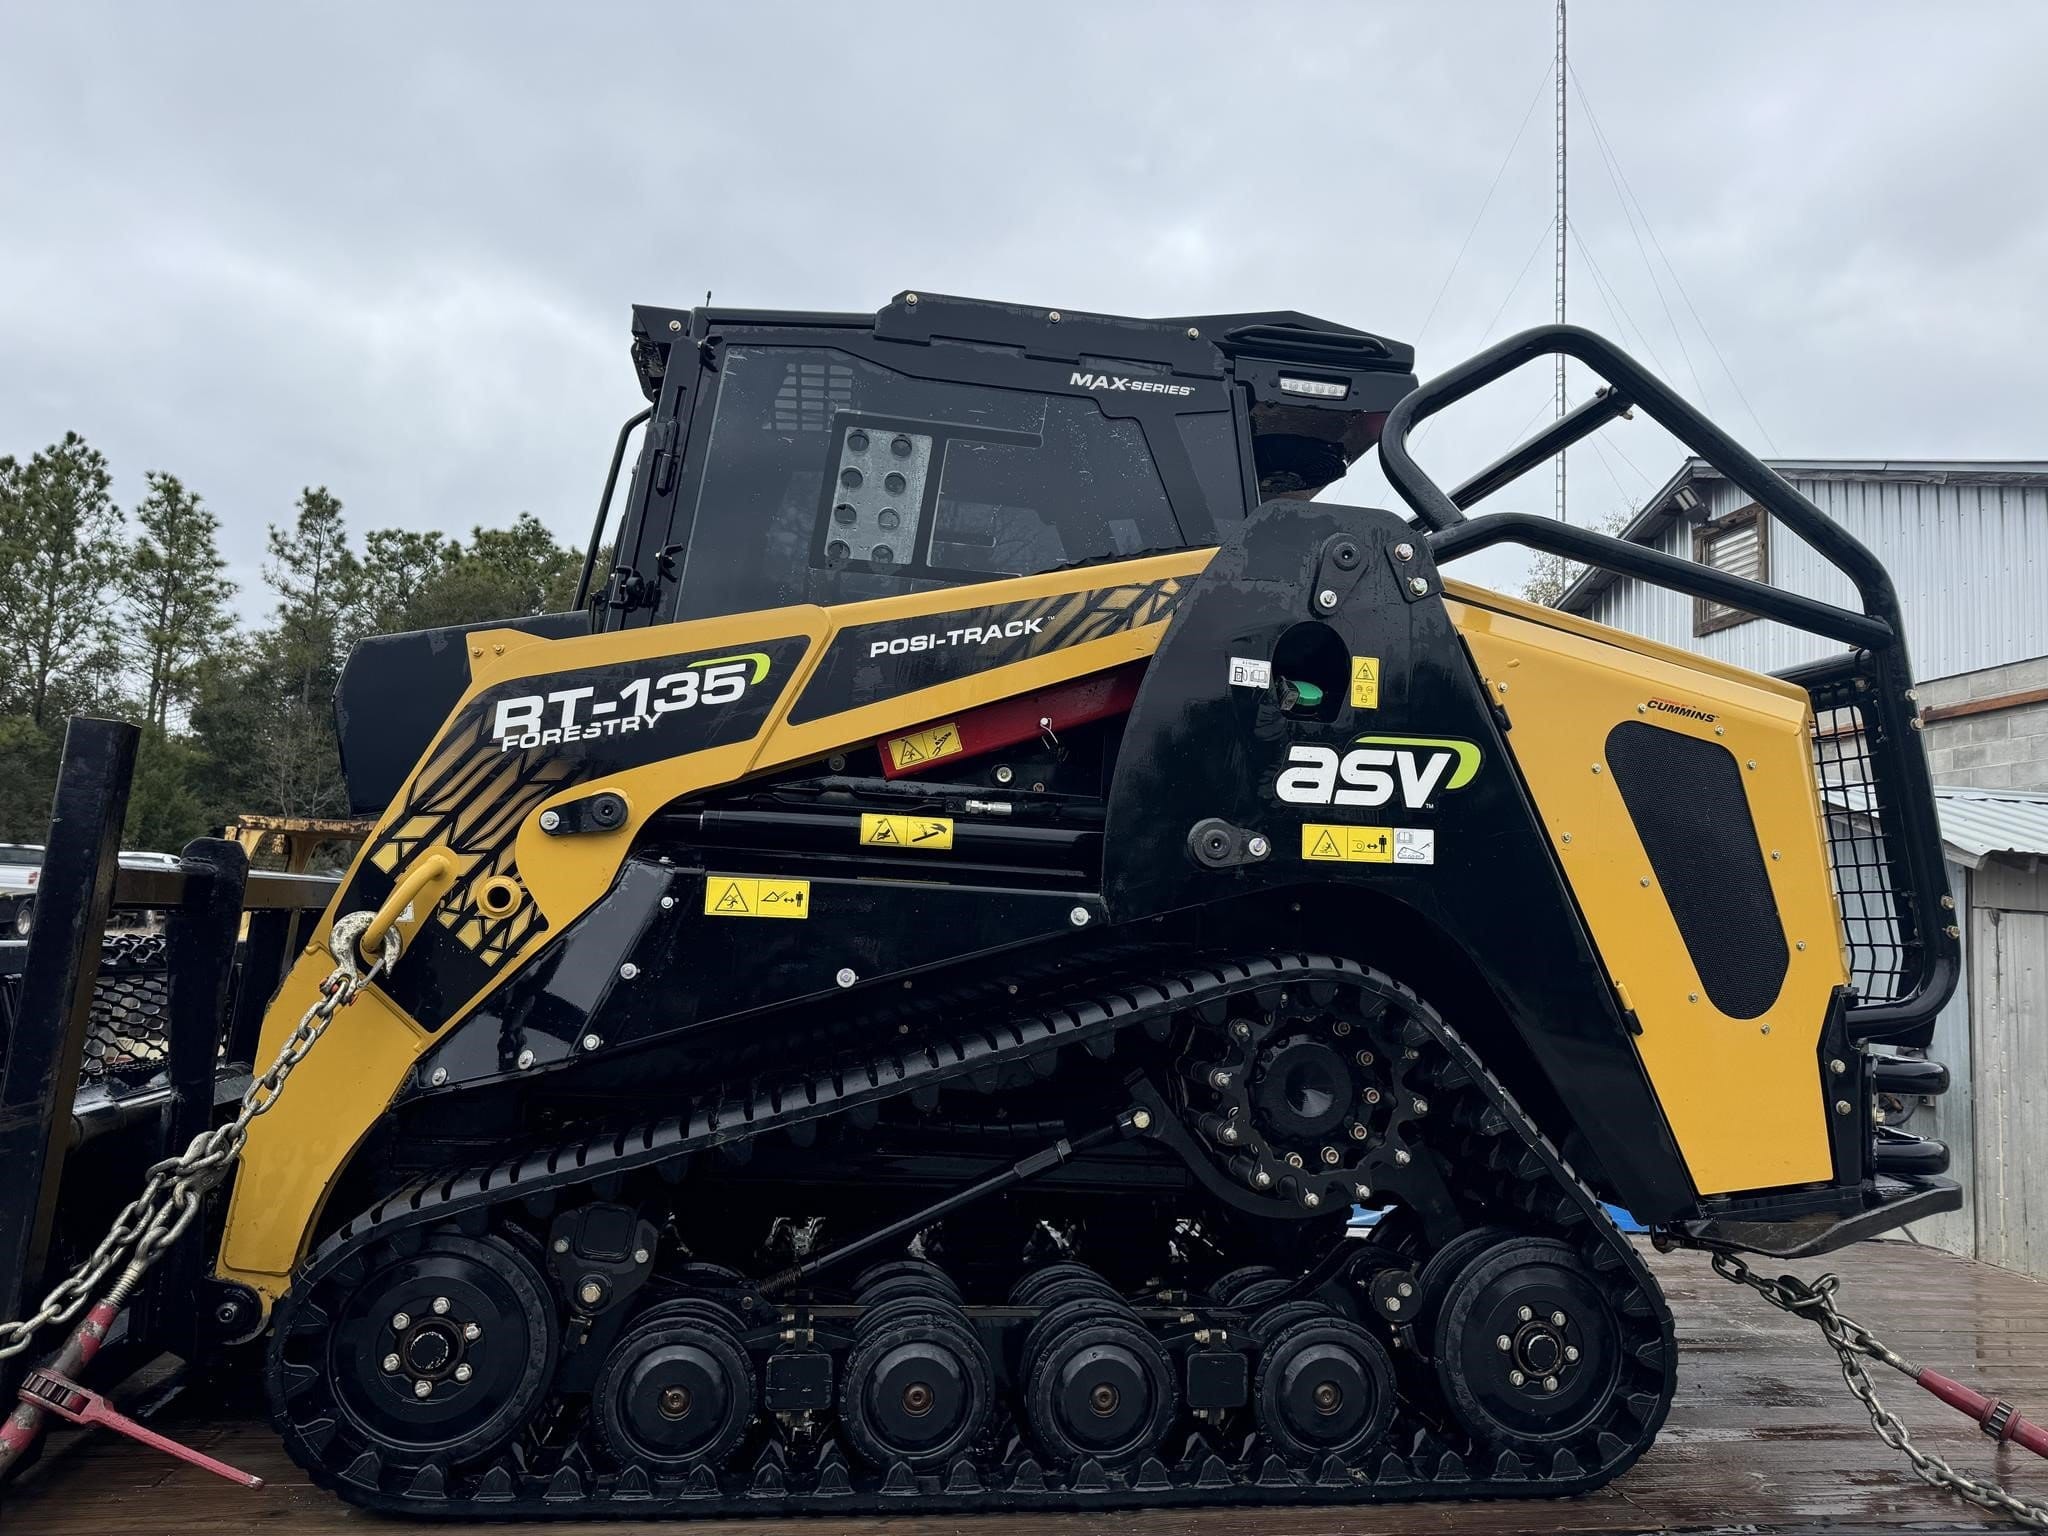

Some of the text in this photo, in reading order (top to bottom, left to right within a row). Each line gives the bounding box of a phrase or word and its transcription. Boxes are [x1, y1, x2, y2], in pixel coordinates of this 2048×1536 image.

[1069, 372, 1191, 396] MAX-SERIES
[870, 617, 1043, 658] POSI-TRACK
[493, 663, 747, 739] RT-135
[1647, 700, 1716, 723] CUMMINS
[501, 712, 663, 752] FORESTRY
